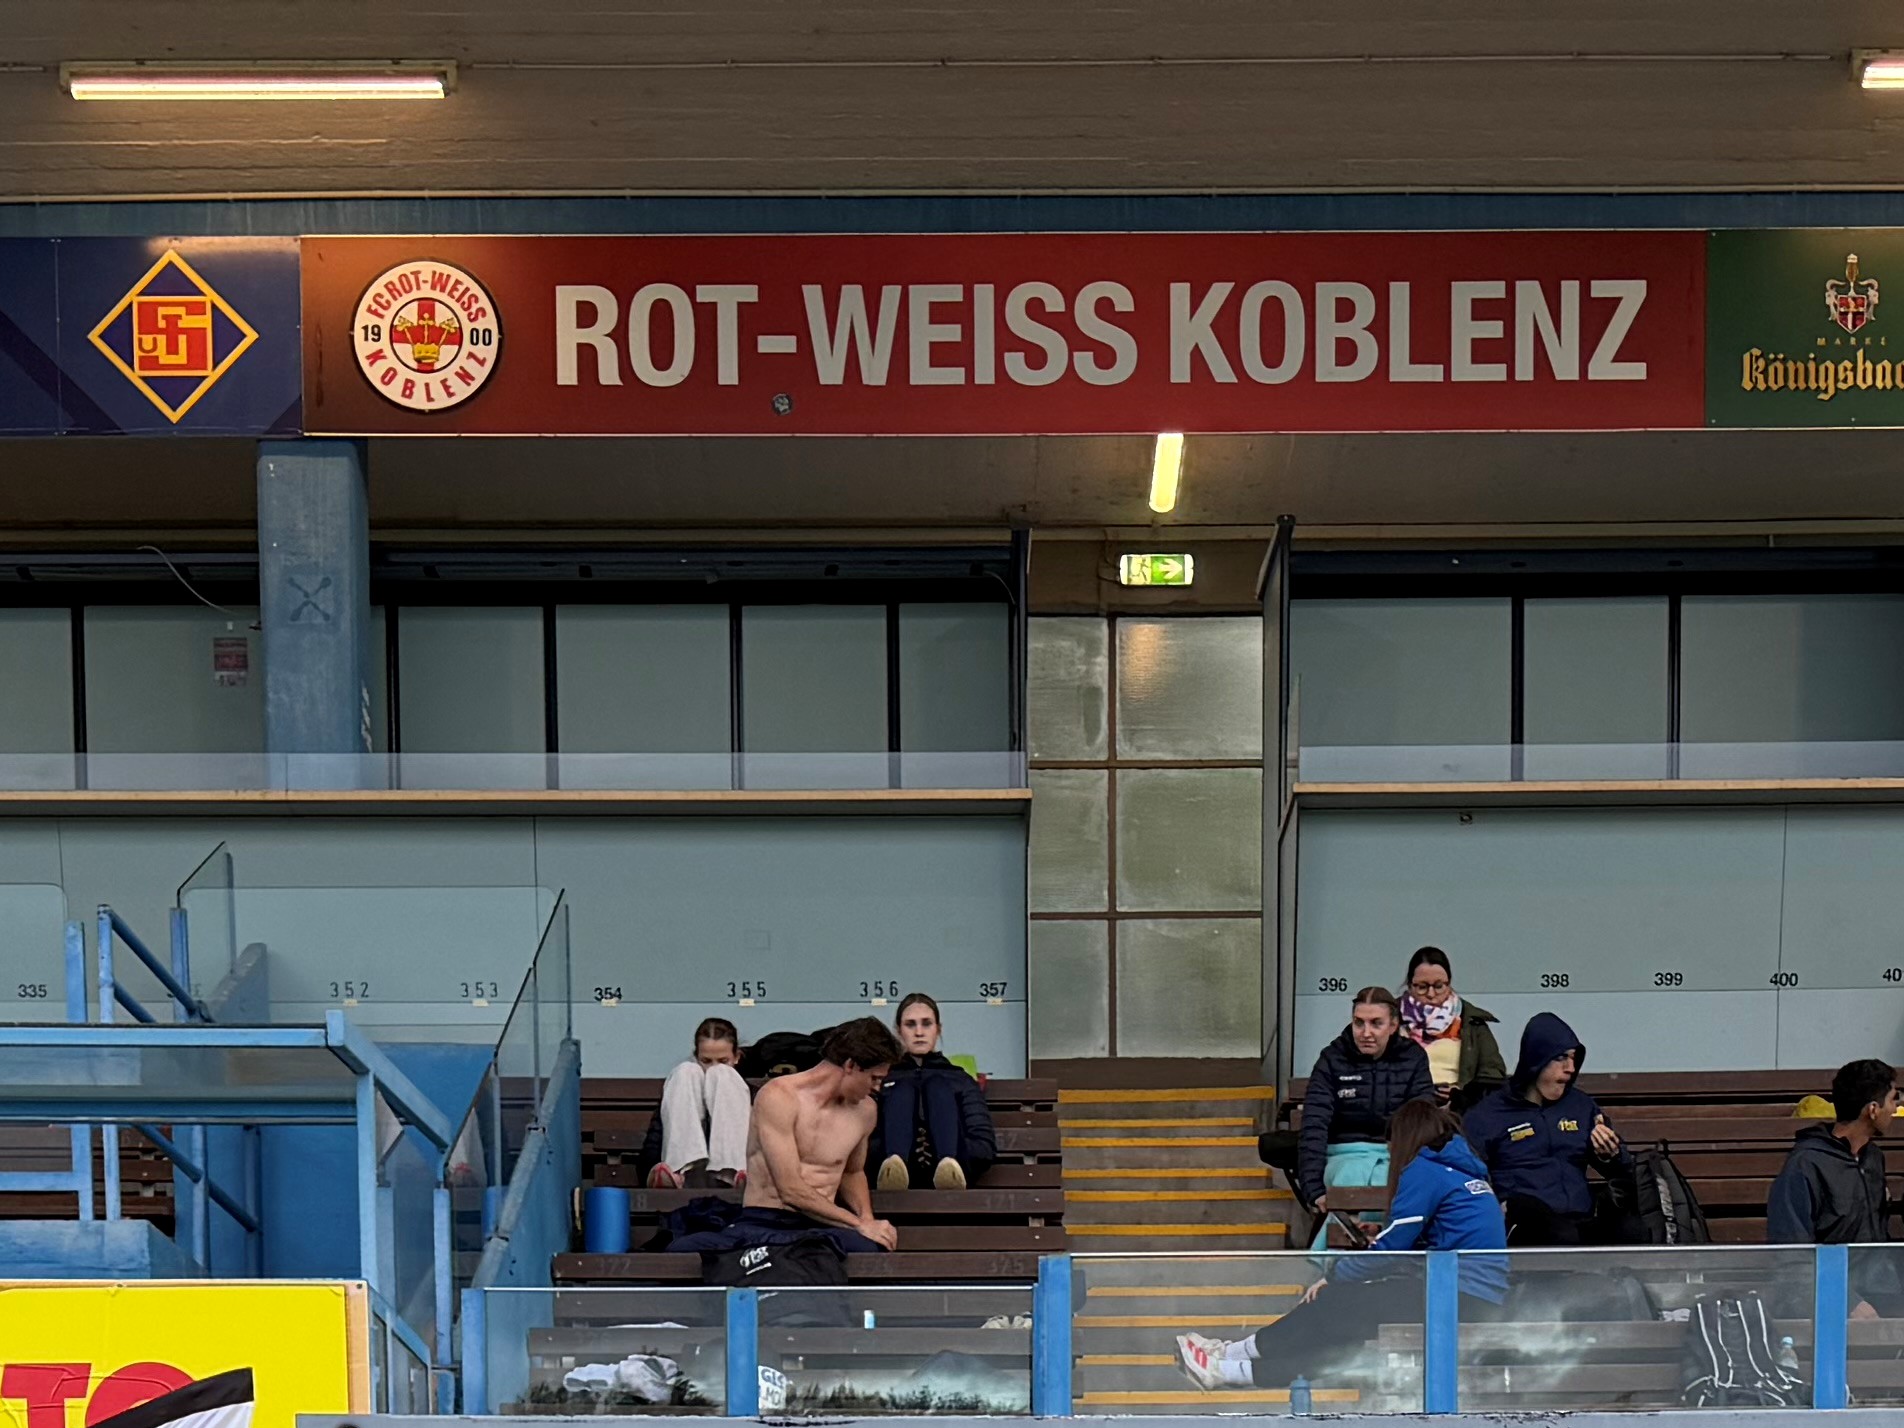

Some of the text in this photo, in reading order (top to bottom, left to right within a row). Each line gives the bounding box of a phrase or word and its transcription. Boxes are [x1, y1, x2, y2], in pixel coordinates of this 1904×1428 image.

[361, 324, 382, 343] 19
[469, 327, 493, 347] 00
[555, 279, 1648, 388] ROT-WEISS KOBLENZ
[365, 348, 488, 403] KOBLENZ
[1318, 976, 1348, 993] 396
[1539, 972, 1570, 989] 398
[1653, 971, 1684, 988] 399
[1769, 971, 1799, 988] 400
[17, 983, 48, 999] 335
[329, 981, 370, 999] 352
[459, 981, 500, 999] 353
[593, 985, 624, 1001] 354
[726, 979, 767, 999] 355
[858, 979, 899, 999] 356
[979, 981, 1008, 998] 357
